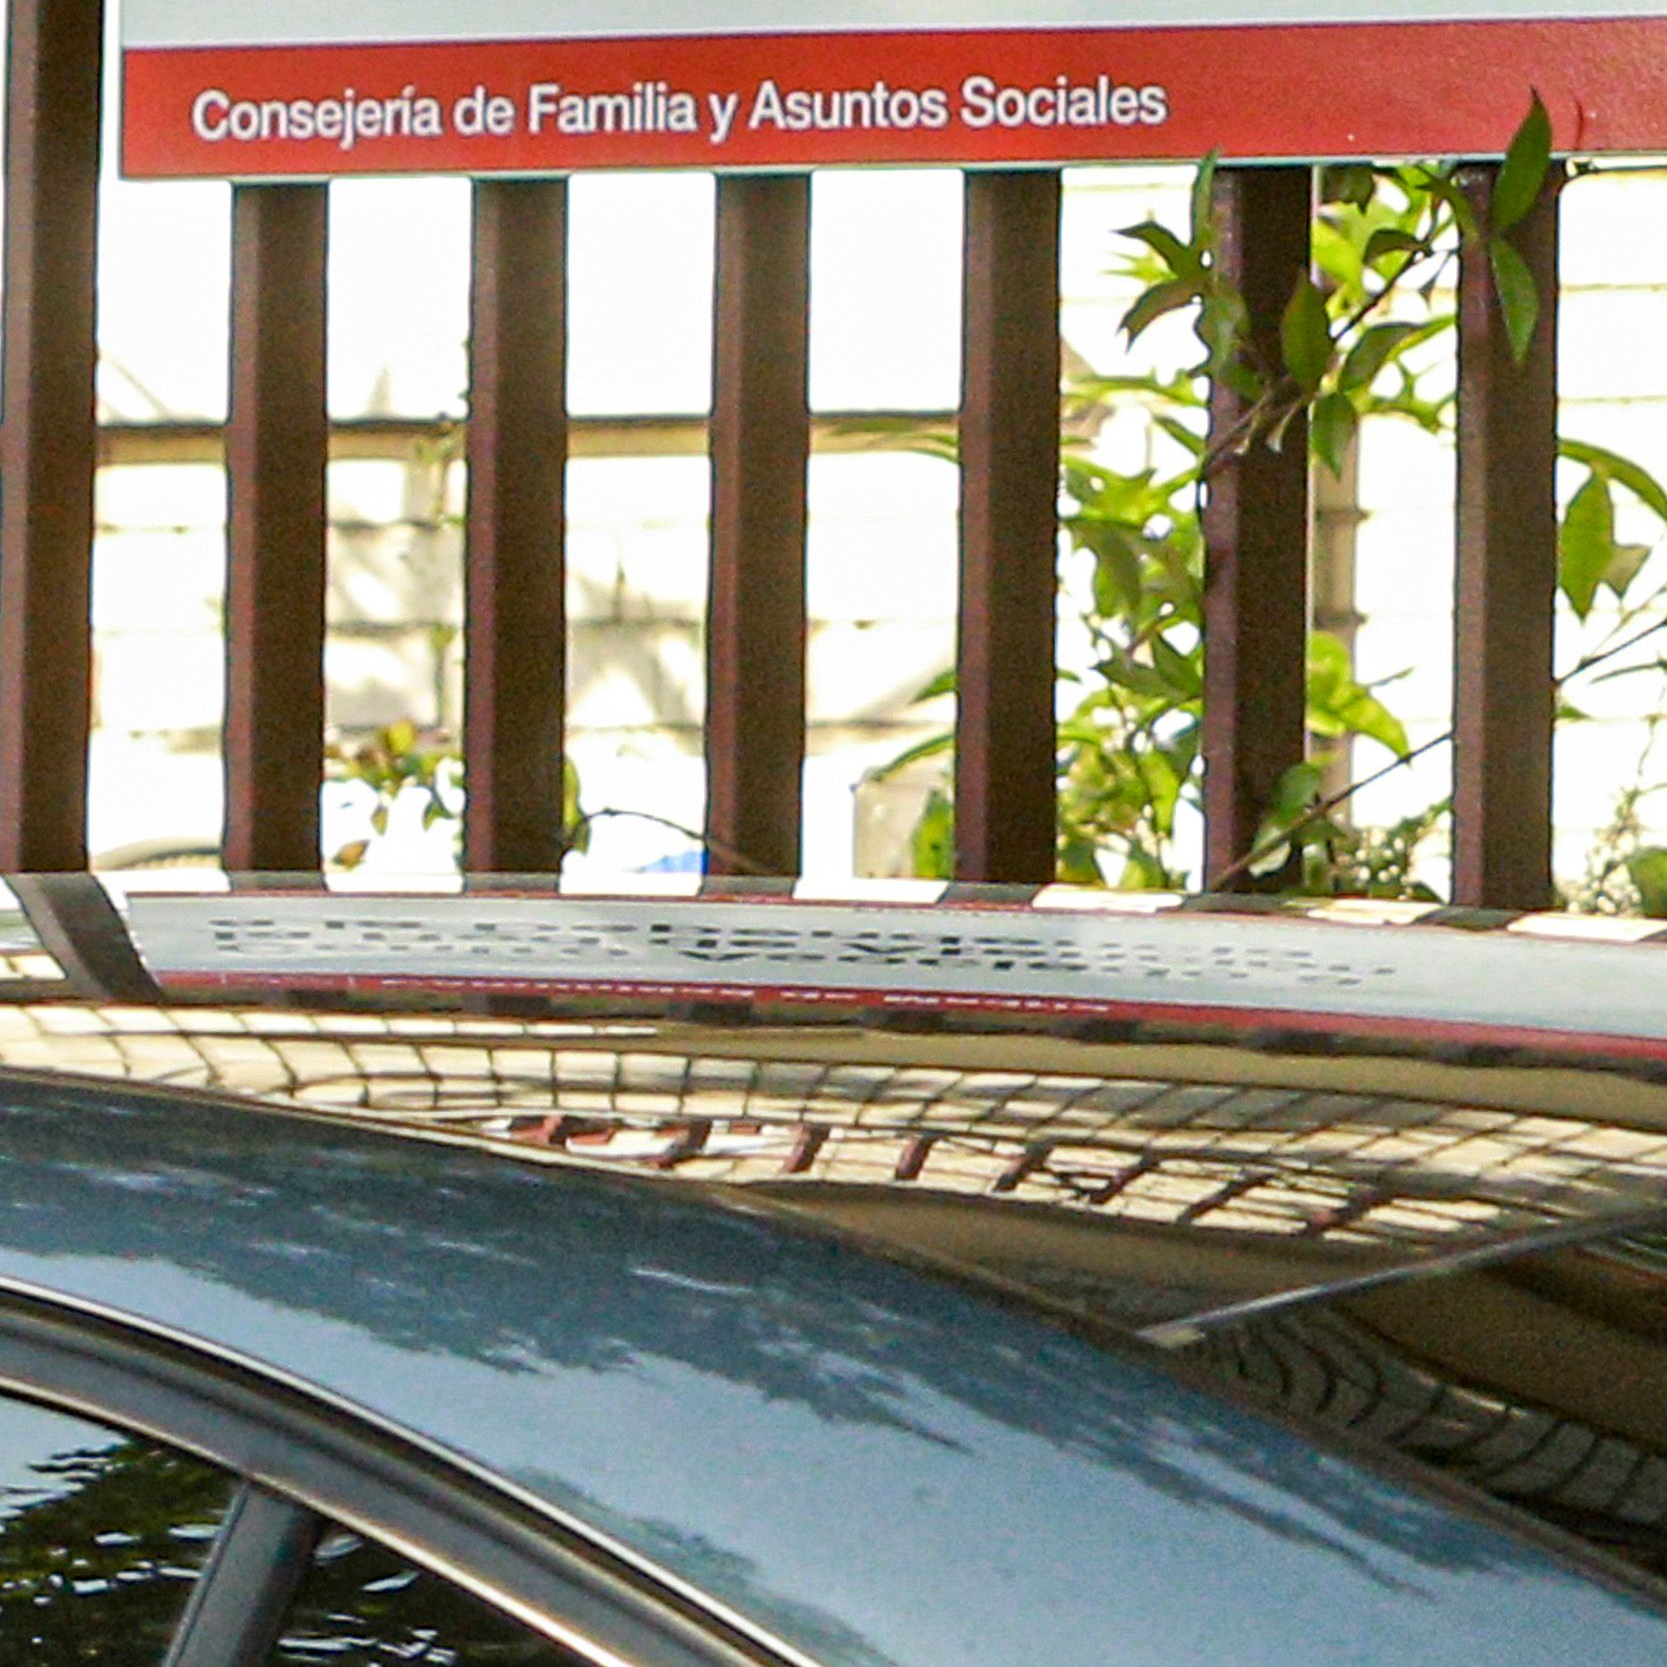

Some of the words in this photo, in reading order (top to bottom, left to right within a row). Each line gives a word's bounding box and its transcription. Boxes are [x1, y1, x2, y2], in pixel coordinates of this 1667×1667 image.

[194, 86, 439, 149] Consejería
[455, 84, 513, 132] de
[528, 81, 695, 131] Familia
[708, 91, 738, 142] y
[749, 79, 947, 130] Asuntos
[960, 75, 1167, 126] Sociales
